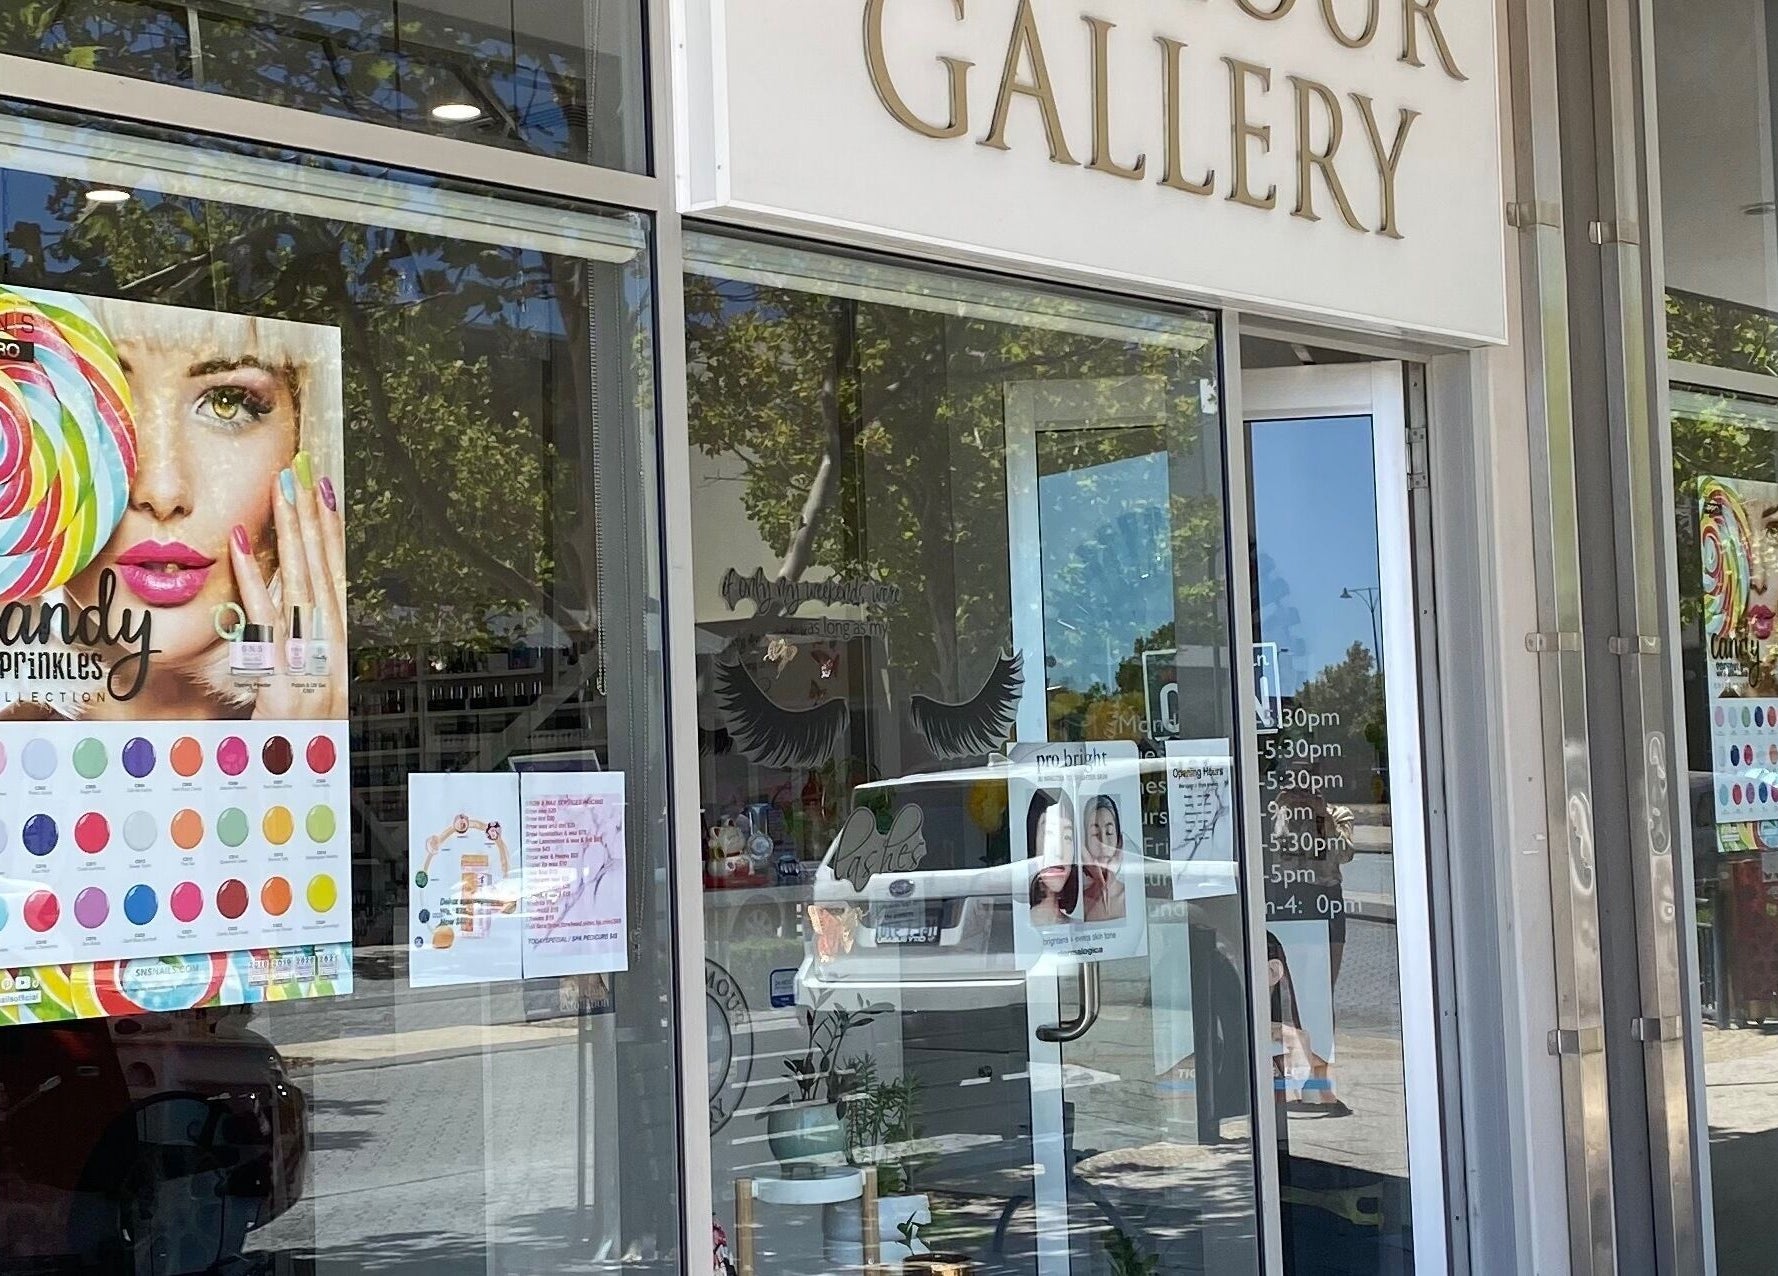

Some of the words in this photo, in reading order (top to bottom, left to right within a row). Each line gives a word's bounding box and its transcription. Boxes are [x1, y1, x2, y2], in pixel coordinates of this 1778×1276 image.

[862, 0, 1422, 240] GALLERY
[0, 568, 163, 702] andy
[823, 616, 850, 640] long
[852, 622, 866, 636] as
[868, 621, 890, 640] my
[5, 691, 106, 703] LLECTION
[1036, 754, 1060, 774] pro
[1063, 747, 1108, 774] bright
